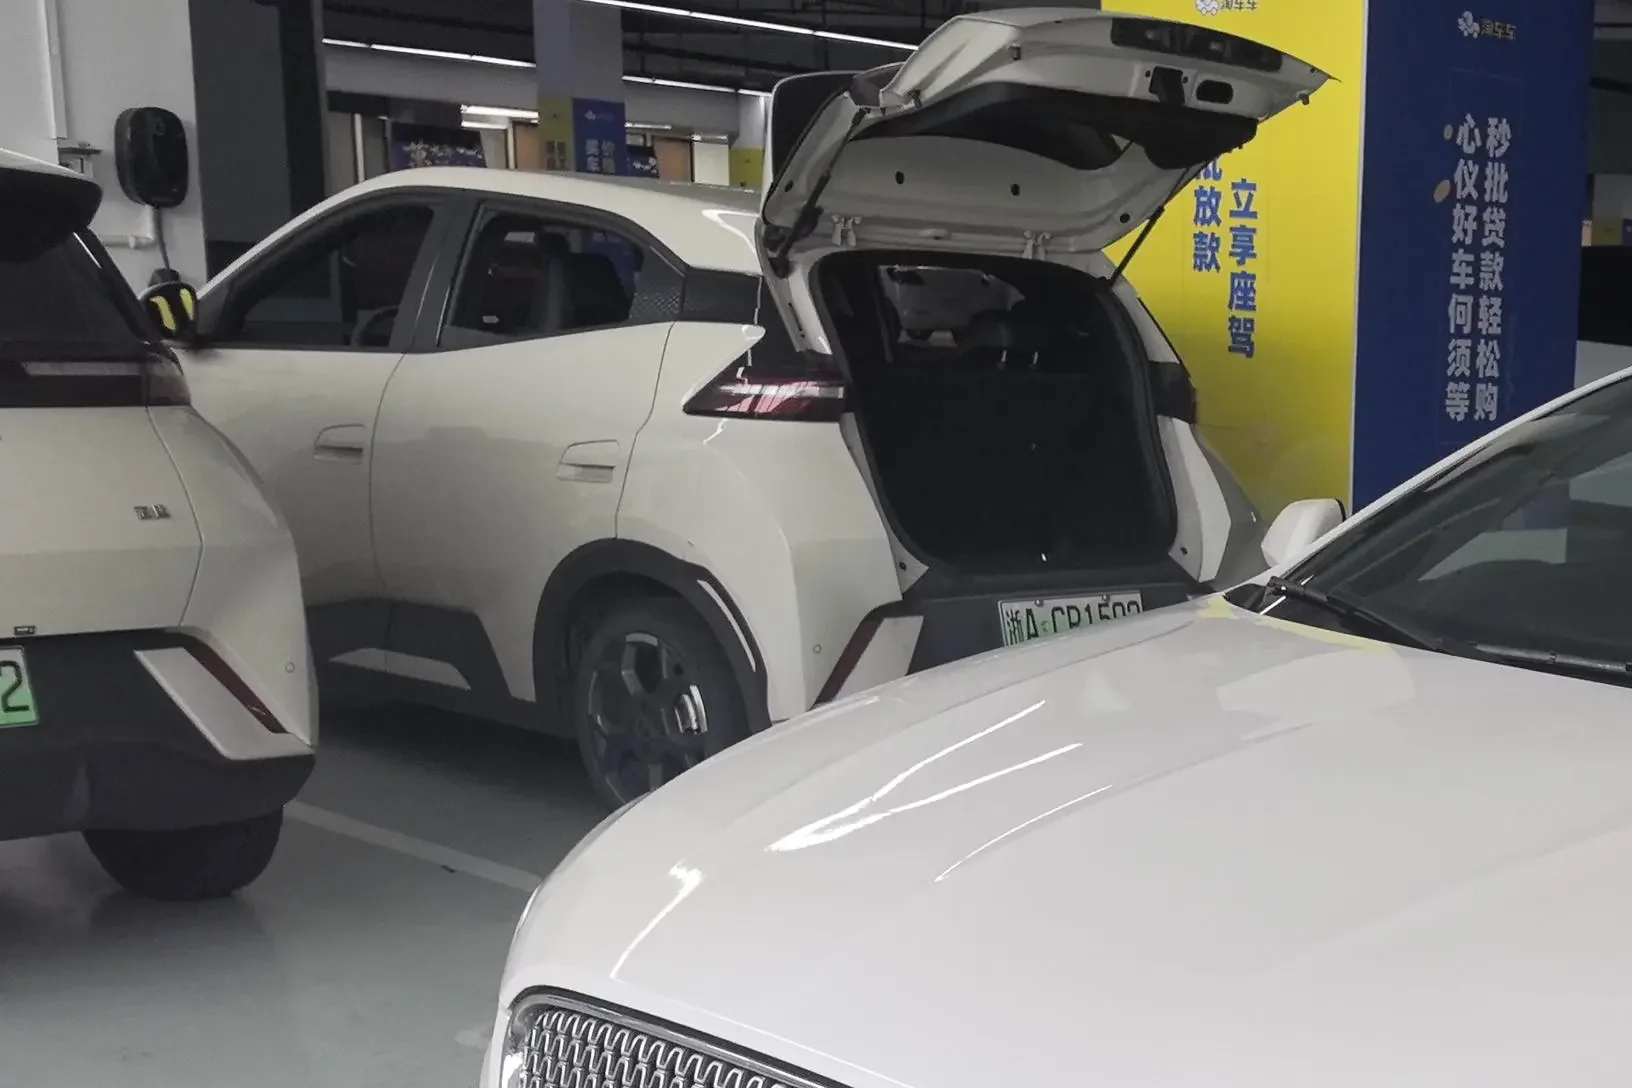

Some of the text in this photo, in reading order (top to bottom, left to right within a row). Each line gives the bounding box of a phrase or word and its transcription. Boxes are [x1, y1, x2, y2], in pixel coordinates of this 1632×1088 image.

[1228, 178, 1258, 358] 立享座驾
[1445, 113, 1481, 422] 心仪好车何须等
[1473, 116, 1511, 421] 秒批贷款轻松购
